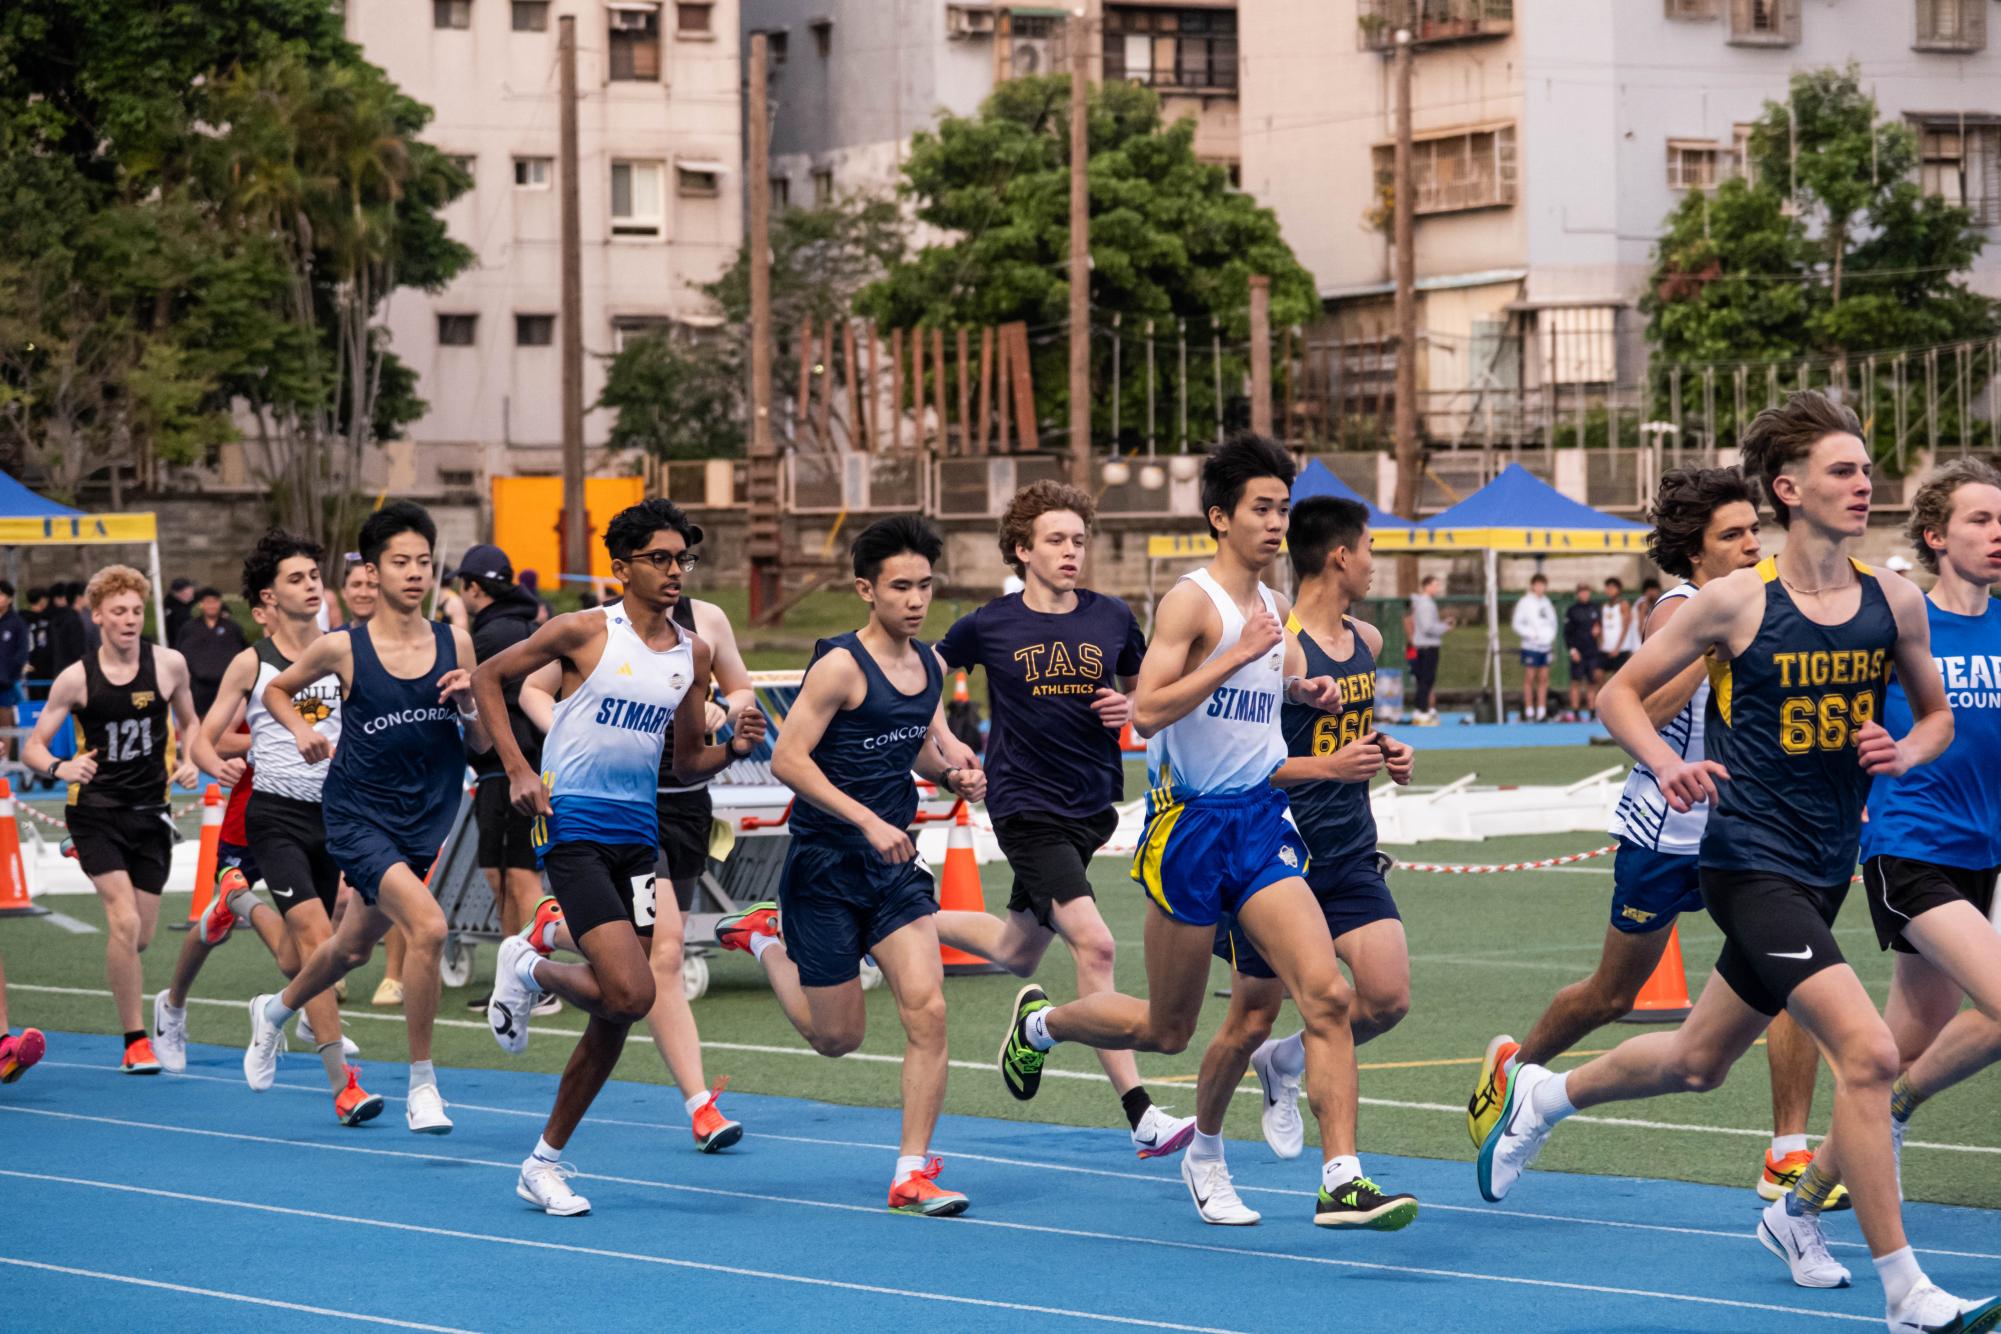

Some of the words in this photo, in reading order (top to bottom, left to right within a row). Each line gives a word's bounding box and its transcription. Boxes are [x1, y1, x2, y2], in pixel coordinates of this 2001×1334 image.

[1014, 641, 1103, 682] TAS
[1773, 649, 1885, 688] TIGERS
[294, 685, 343, 702] NILA
[1032, 684, 1094, 696] ATHLETICS
[1336, 671, 1376, 705] GERS
[105, 717, 153, 762] 121
[863, 725, 930, 750] CONCOR
[1779, 689, 1876, 755] 669
